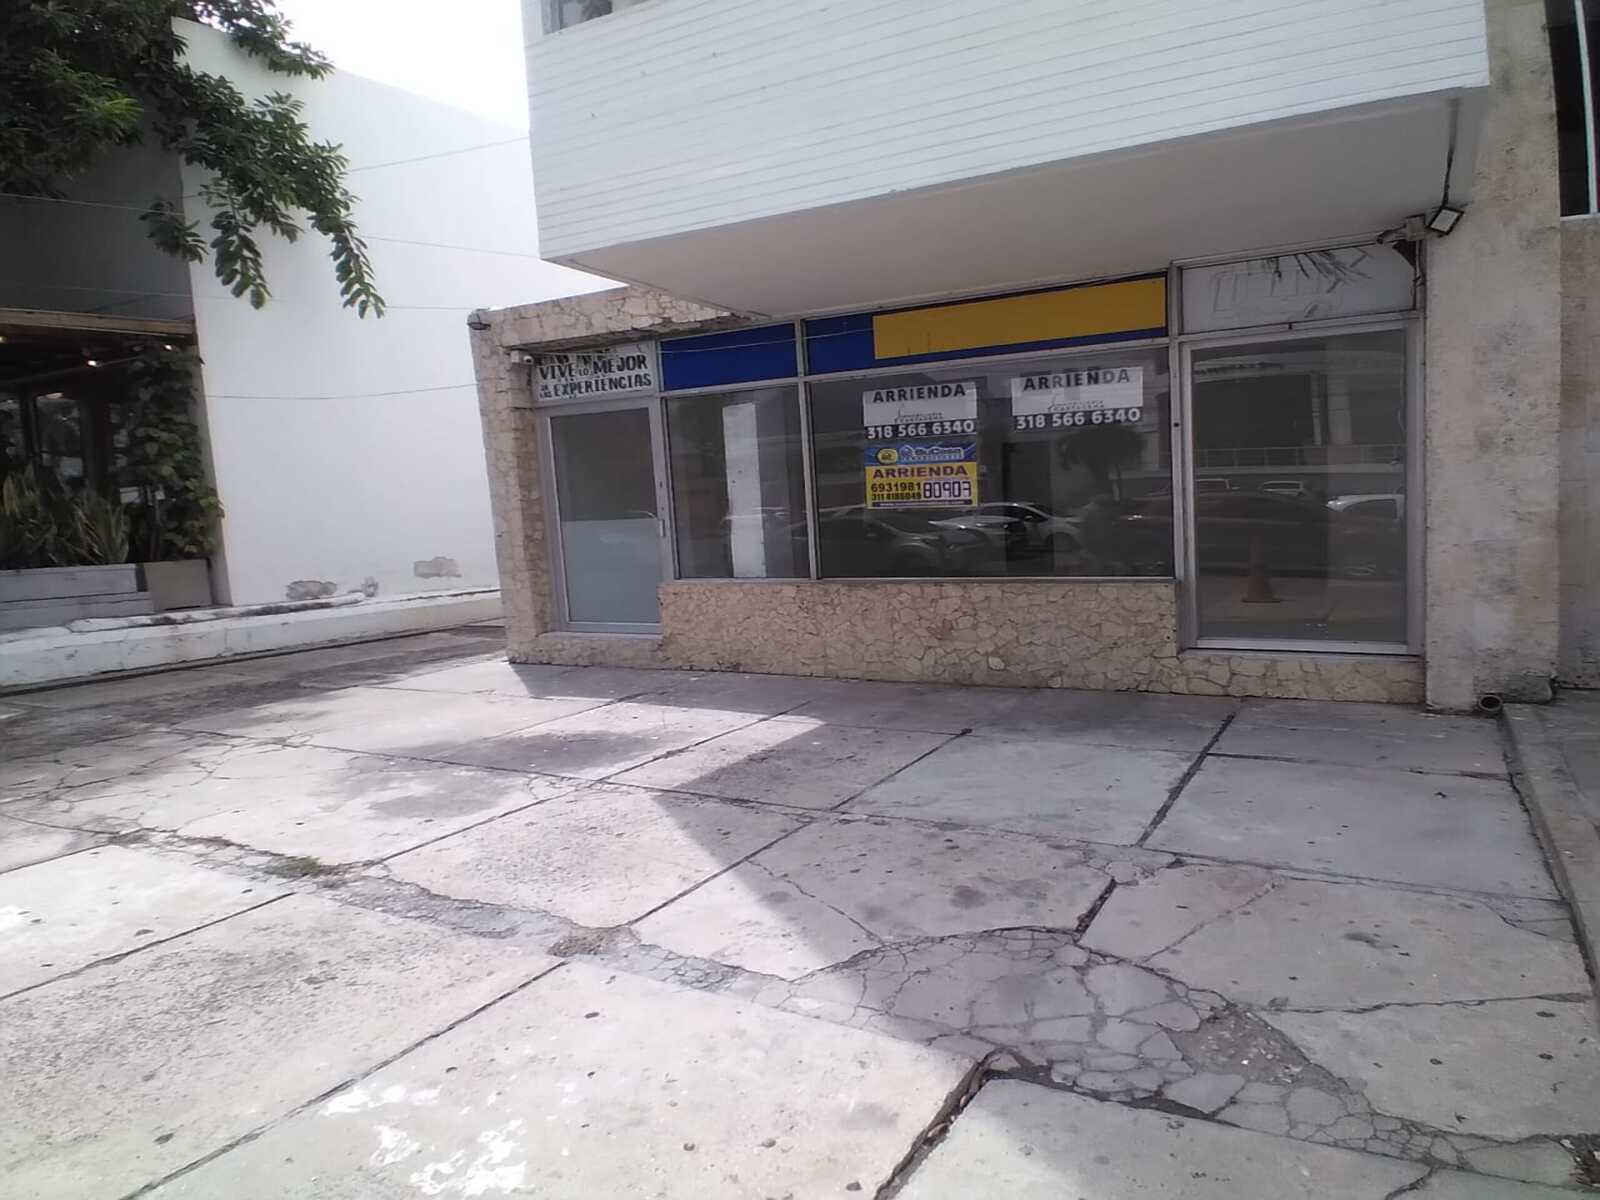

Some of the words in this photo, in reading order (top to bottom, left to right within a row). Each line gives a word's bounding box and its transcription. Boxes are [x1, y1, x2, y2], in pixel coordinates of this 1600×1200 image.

[540, 364, 575, 379] VIVE
[593, 355, 648, 374] MEJOR
[554, 374, 652, 397] EXPERIENCIAS
[1024, 369, 1130, 390] ARRIENDA
[873, 384, 966, 402] ARRIENDA
[1016, 415, 1046, 430] 318
[1052, 411, 1085, 428] 566
[1091, 407, 1141, 425] 6340
[867, 425, 893, 440] 318
[898, 423, 927, 437] 566
[932, 420, 975, 435] 6340
[872, 465, 969, 479] ARRIENDA
[871, 481, 921, 493] 6931981
